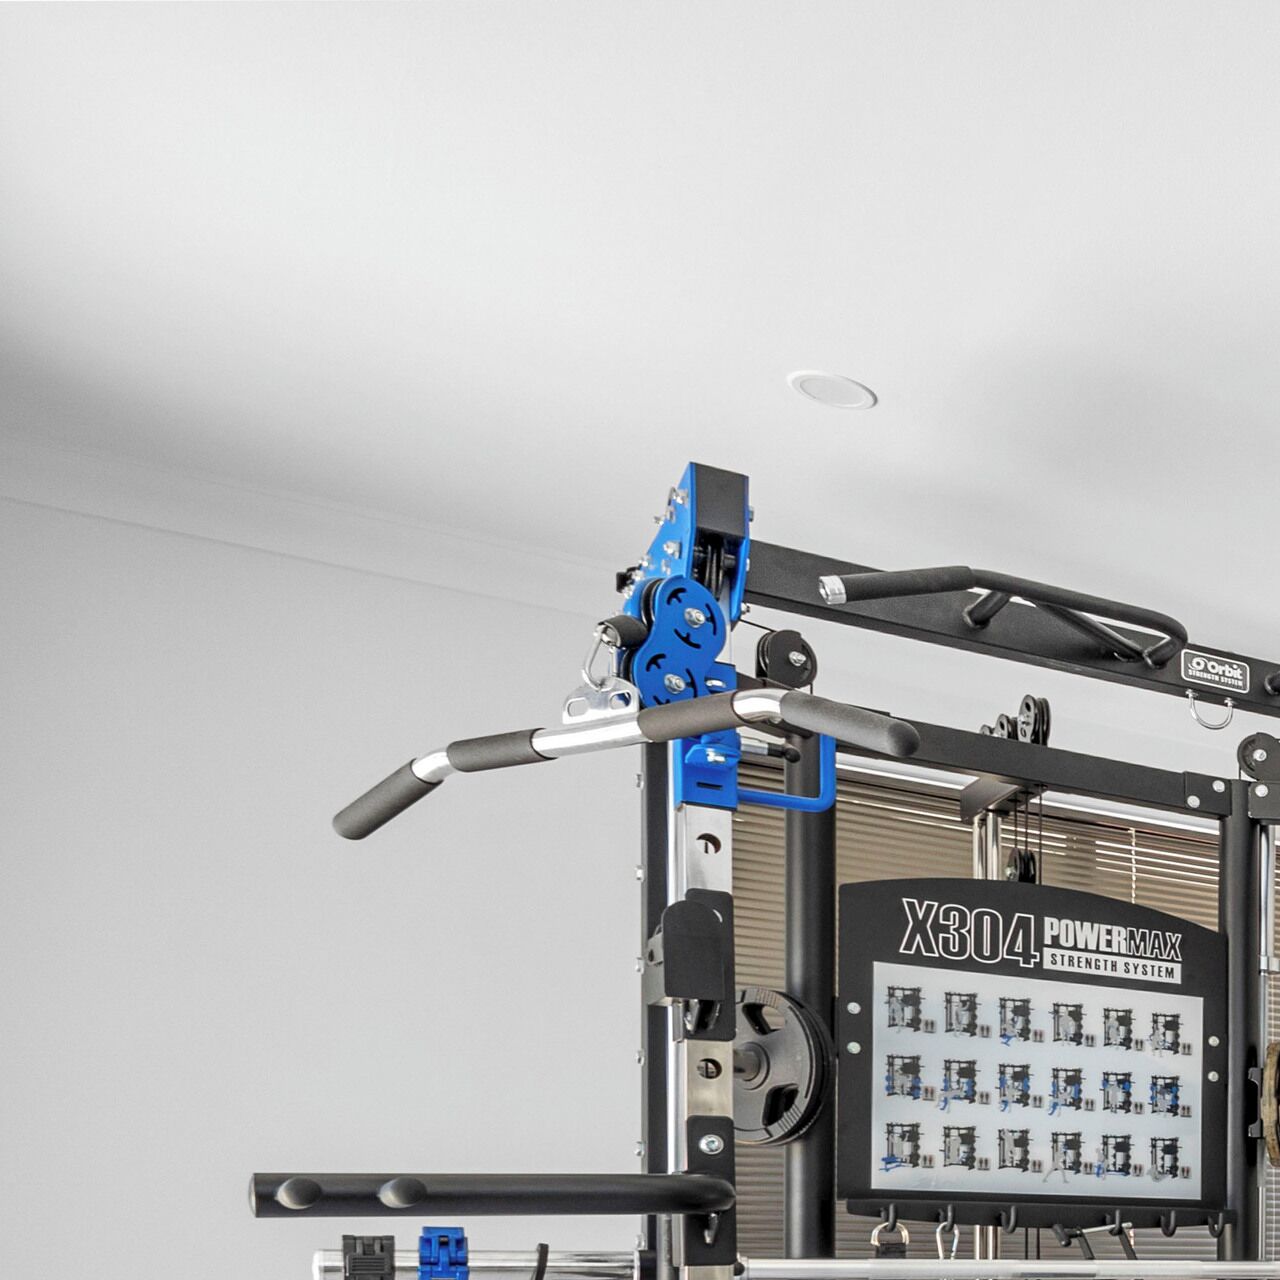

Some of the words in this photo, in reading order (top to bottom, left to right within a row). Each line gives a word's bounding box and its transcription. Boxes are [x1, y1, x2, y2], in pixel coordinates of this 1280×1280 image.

[1207, 661, 1243, 680] Orbit
[900, 898, 1040, 968] X304
[1043, 916, 1182, 961] POWERMAX
[1050, 953, 1118, 972] STRENGTH
[1124, 962, 1175, 979] SYSTEM
